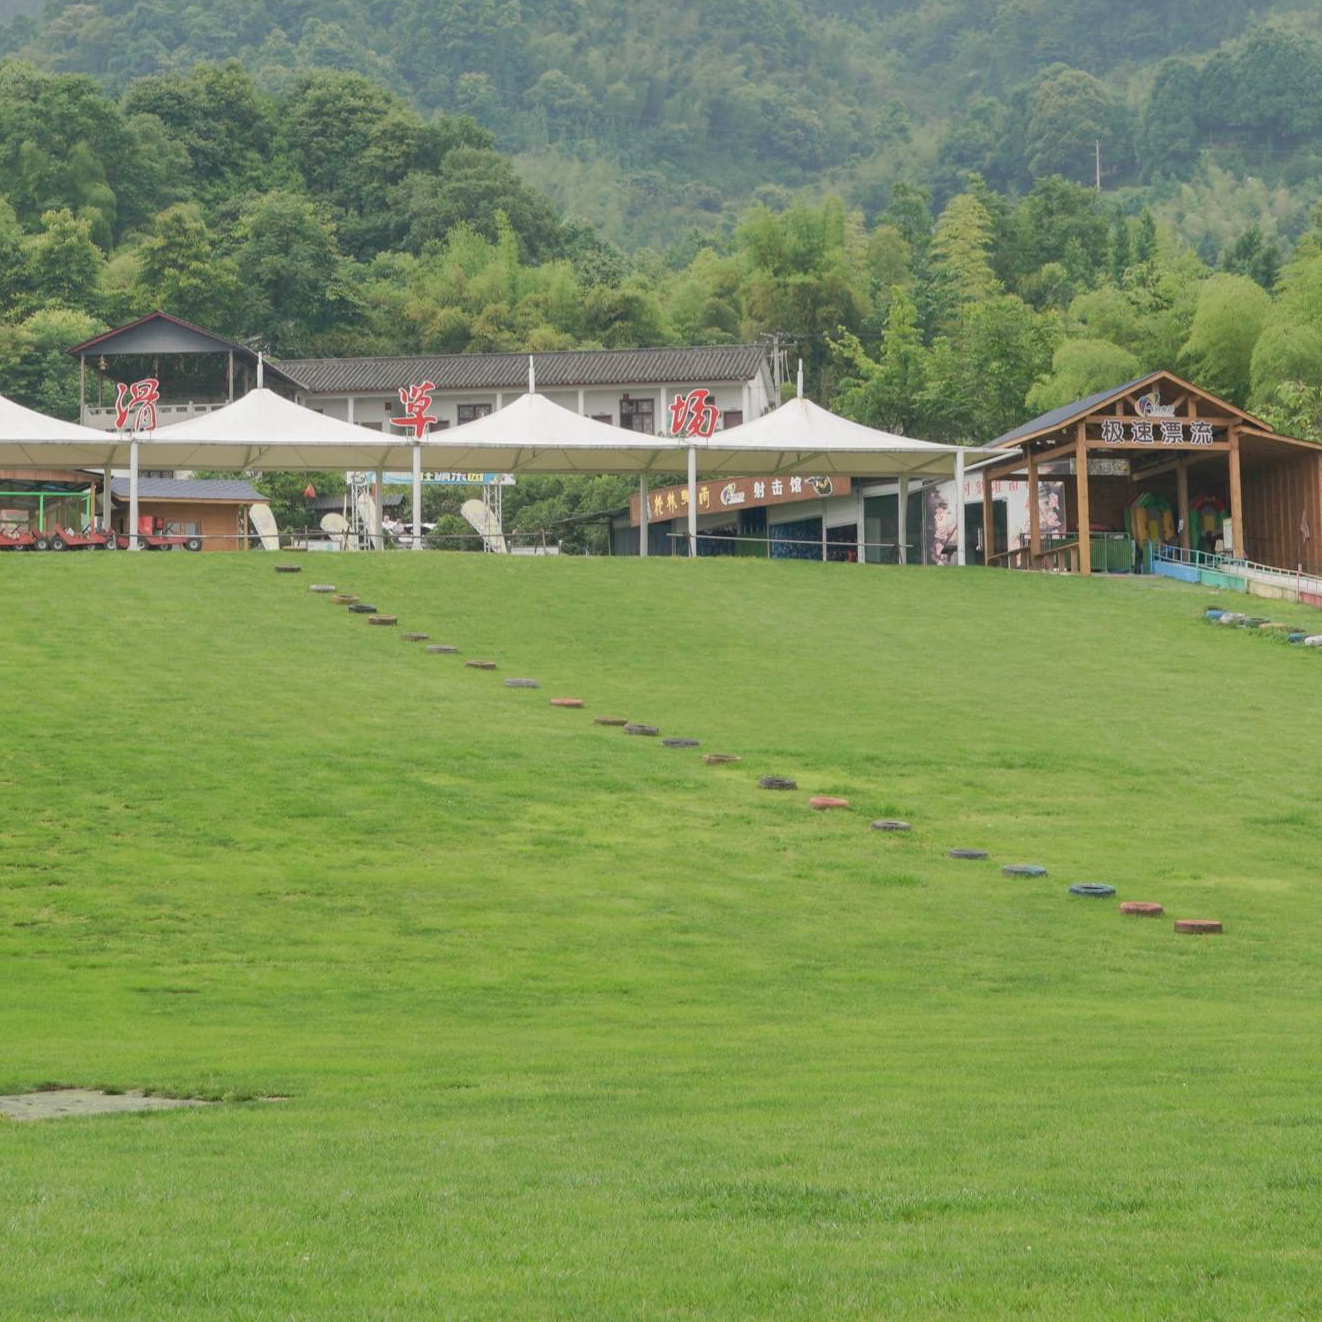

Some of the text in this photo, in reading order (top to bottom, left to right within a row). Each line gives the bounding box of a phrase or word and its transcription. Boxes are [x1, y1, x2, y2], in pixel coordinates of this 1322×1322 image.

[115, 378, 159, 430] 滑
[389, 381, 437, 439] 草
[668, 389, 719, 438] 场
[1101, 419, 1213, 445] 极速漂流
[753, 476, 802, 499] 射击馆
